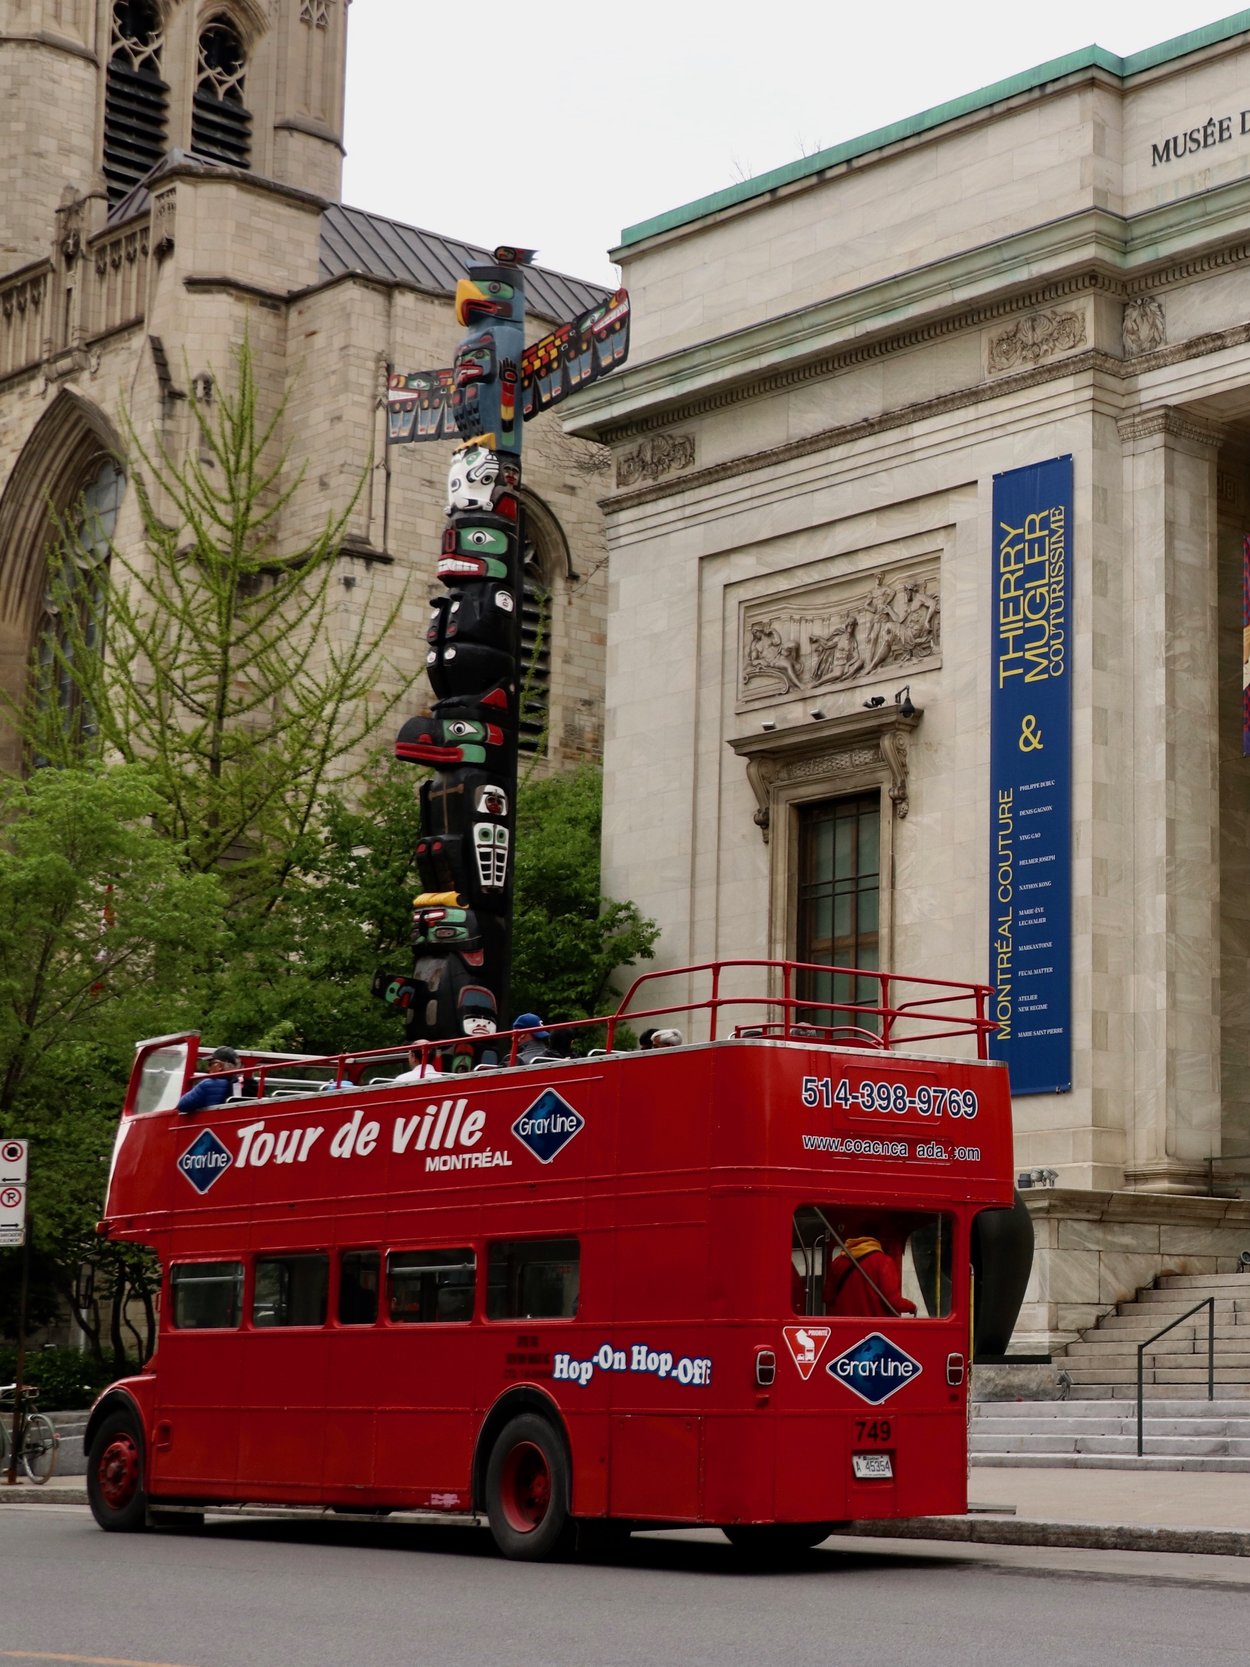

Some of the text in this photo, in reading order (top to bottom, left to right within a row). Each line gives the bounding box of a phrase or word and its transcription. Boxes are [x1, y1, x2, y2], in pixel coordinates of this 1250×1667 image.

[1150, 117, 1232, 167] MUSÉE
[999, 521, 1024, 689] THIERRY
[1024, 509, 1049, 683] MUGLER
[1049, 505, 1066, 677] COUTURISSIME
[1018, 715, 1044, 752] &
[994, 787, 1013, 1041] MONTRÉAL COUTURE
[802, 1076, 979, 1119] 514-398-9769
[234, 1098, 486, 1169] Tour de ville
[425, 1146, 512, 1173] MONTRÉAL
[553, 1344, 712, 1385] Hop-On Hop-Off
[854, 1420, 892, 1443] 749
[856, 1460, 891, 1472] A 45354
